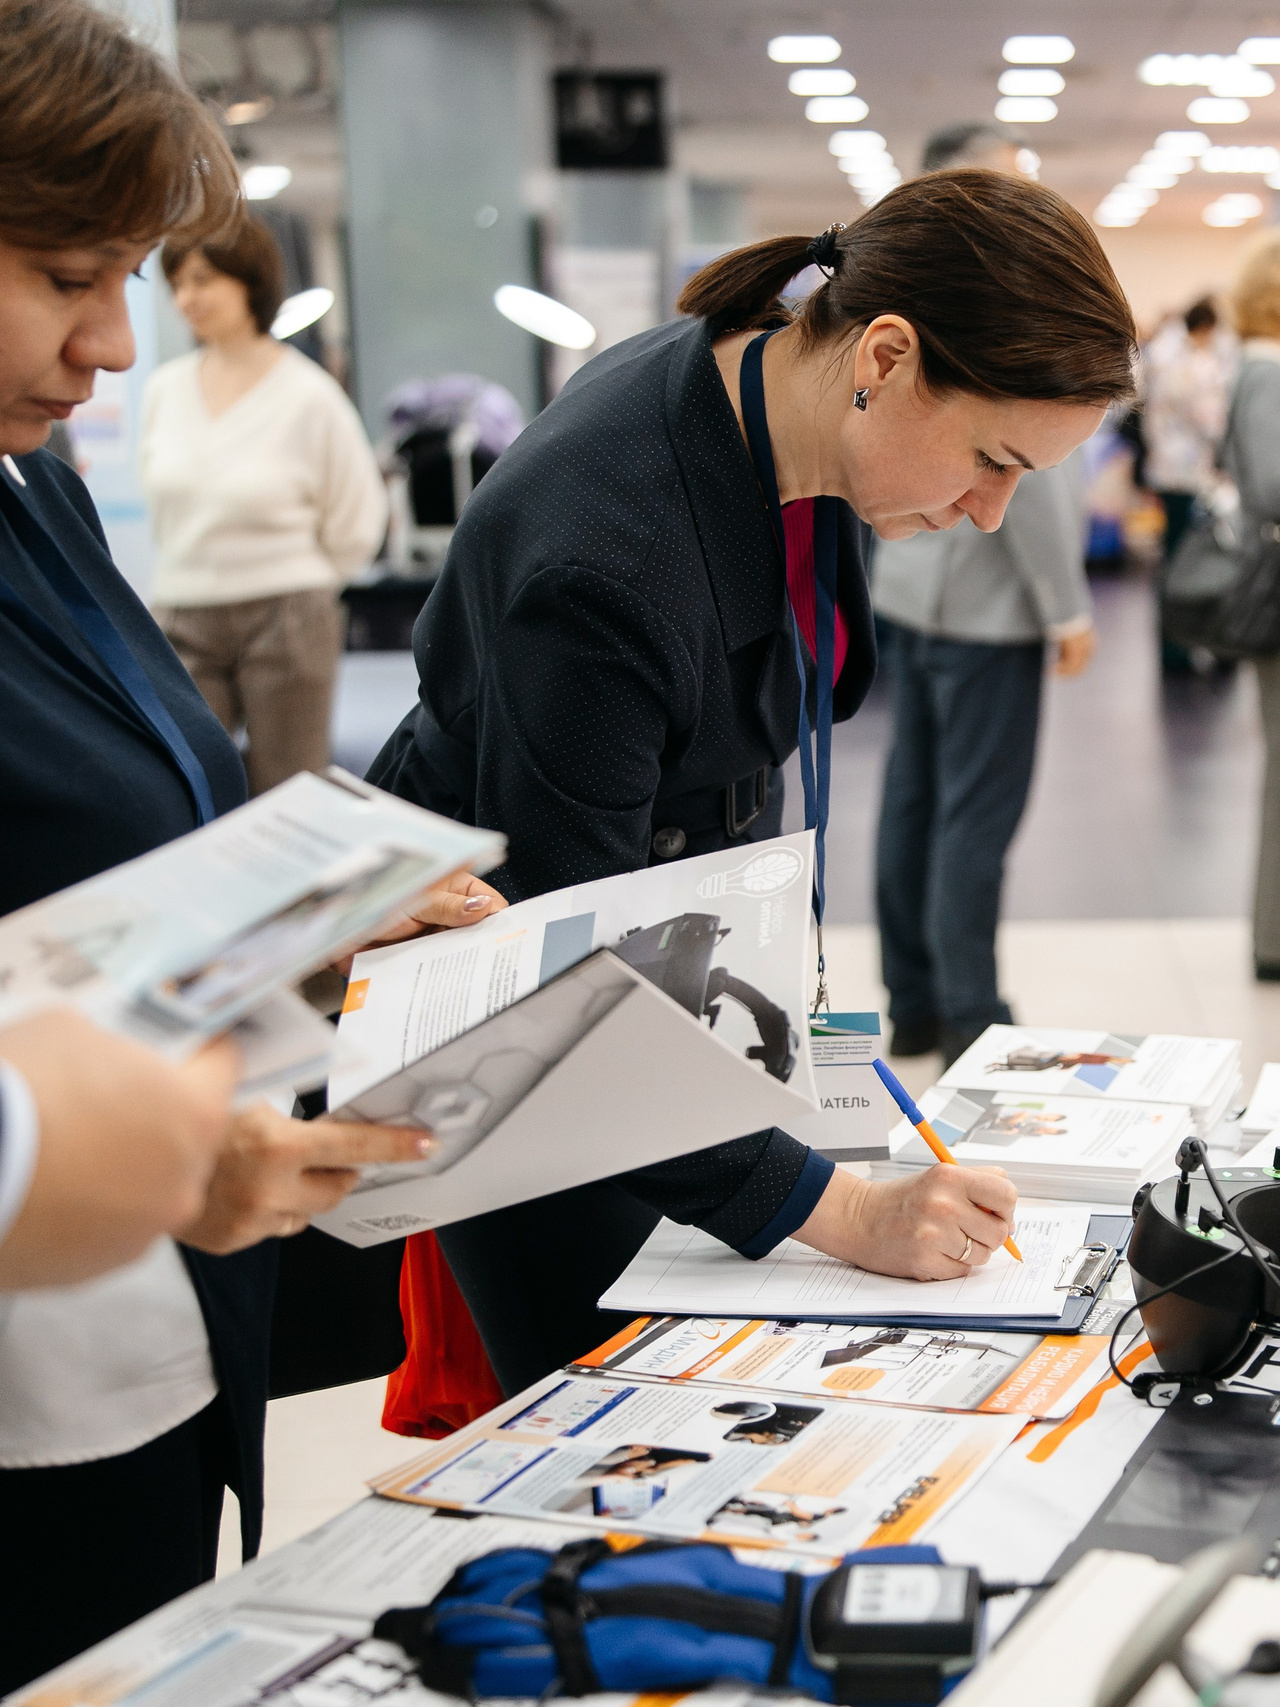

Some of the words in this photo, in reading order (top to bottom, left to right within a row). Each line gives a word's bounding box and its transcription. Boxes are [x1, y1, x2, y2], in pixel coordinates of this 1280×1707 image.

[639, 1336, 698, 1368] МАДИН
[1048, 1348, 1085, 1377] КАРДИО
[989, 1346, 1061, 1409] РЕАБИЛИТАЦИЯ
[1015, 1383, 1050, 1411] НЕЙРО
